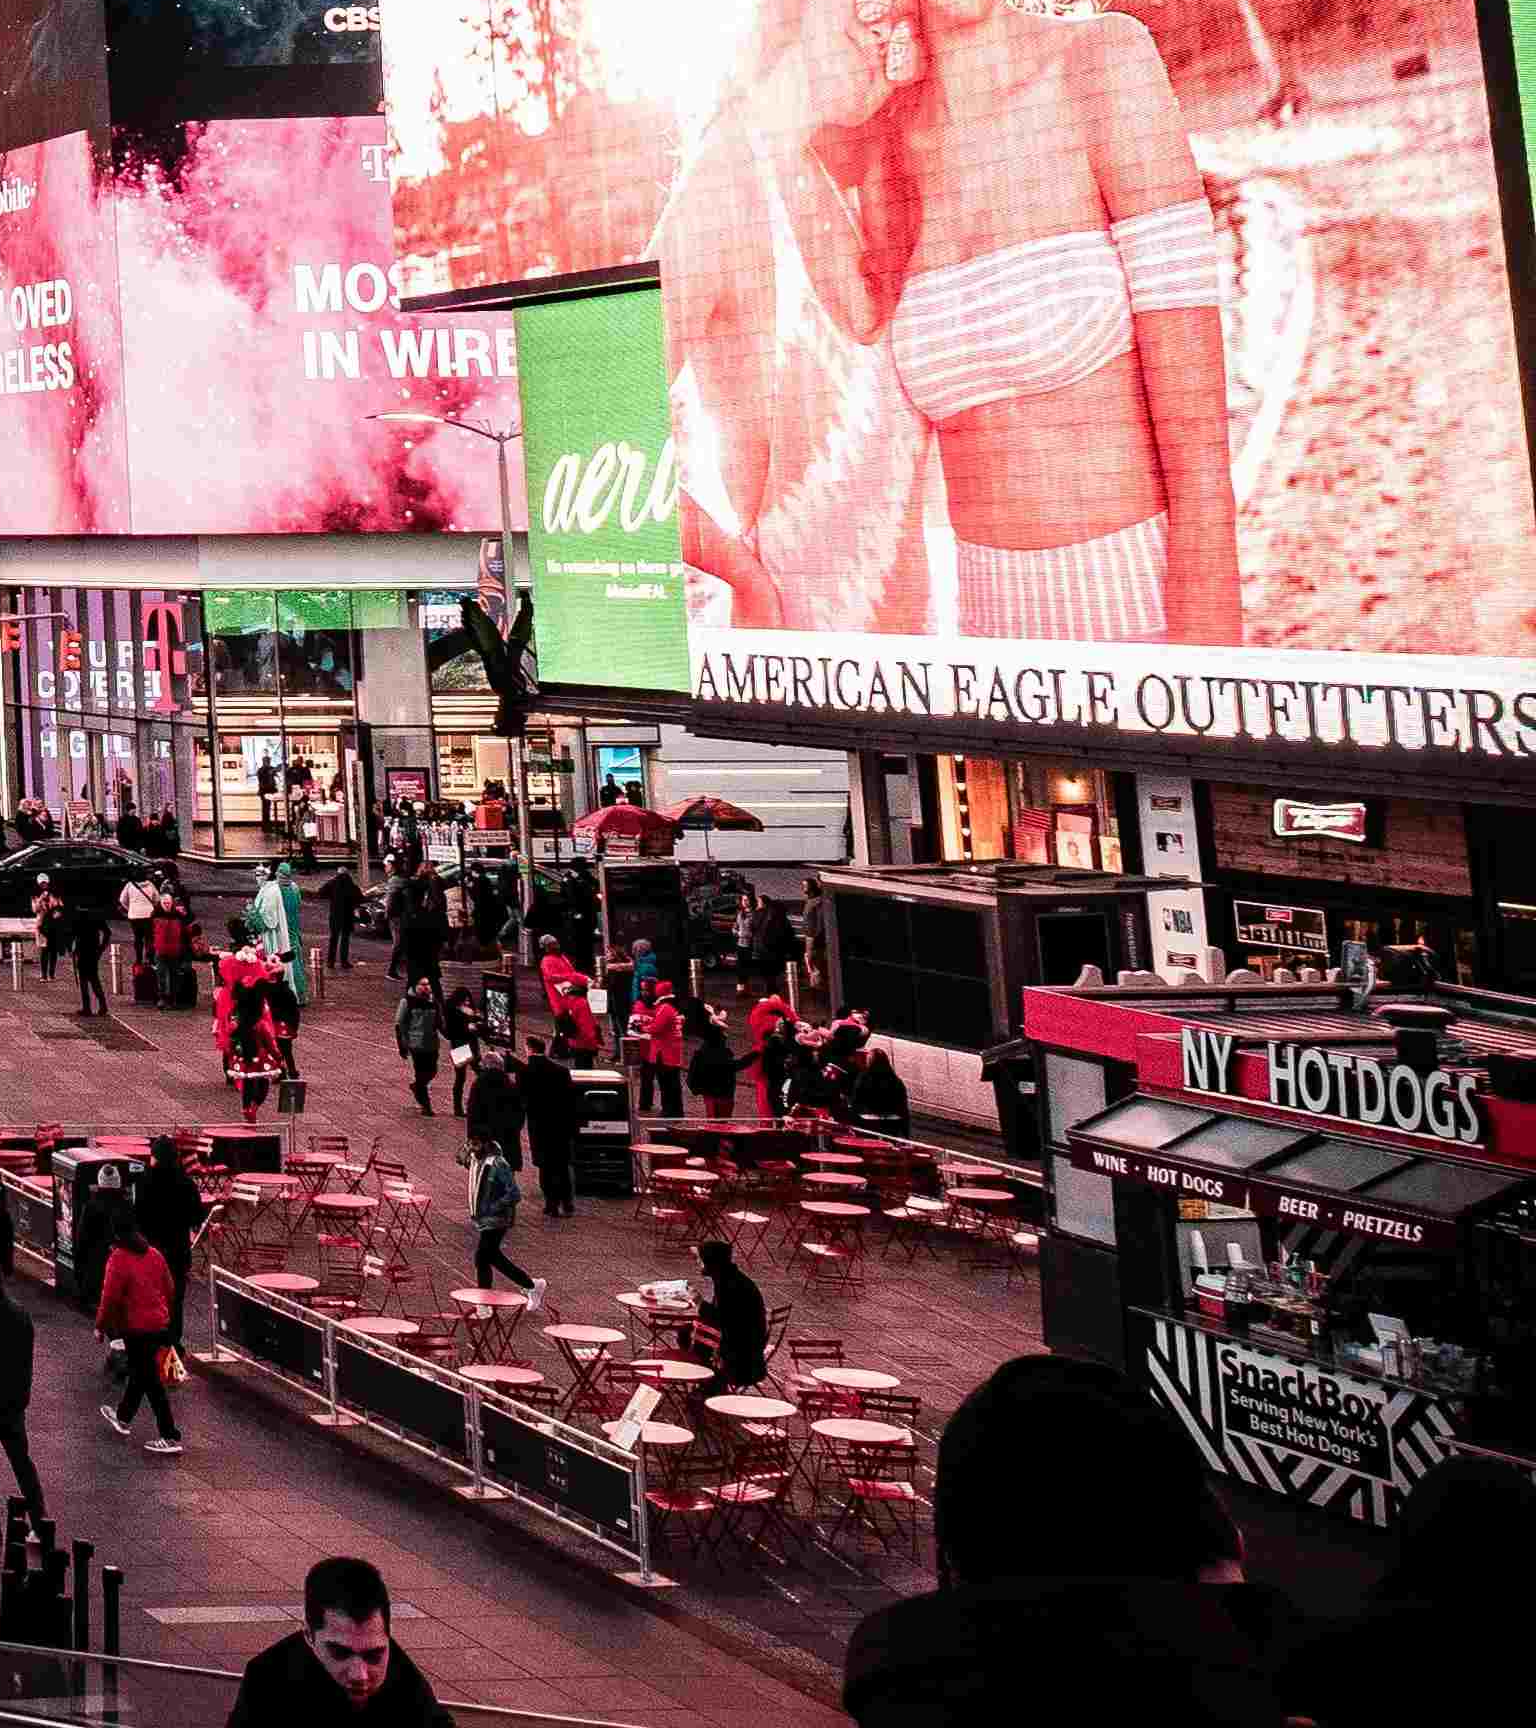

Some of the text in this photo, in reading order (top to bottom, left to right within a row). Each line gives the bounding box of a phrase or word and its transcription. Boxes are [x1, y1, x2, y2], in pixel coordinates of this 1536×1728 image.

[323, 6, 381, 32] CBS
[303, 329, 361, 380] IN
[696, 651, 931, 715] AMERICAN
[949, 662, 1120, 728] EAGLE
[1181, 1027, 1482, 1144] NY HOTDOGS
[1092, 1151, 1224, 1198] WINE HOT DOGS
[1278, 1195, 1424, 1243] BEER PRETZELS
[1218, 1348, 1388, 1424] SnackBox
[1230, 1387, 1378, 1448] Serving New York's
[1249, 1413, 1361, 1464] Best Hot Dogs
